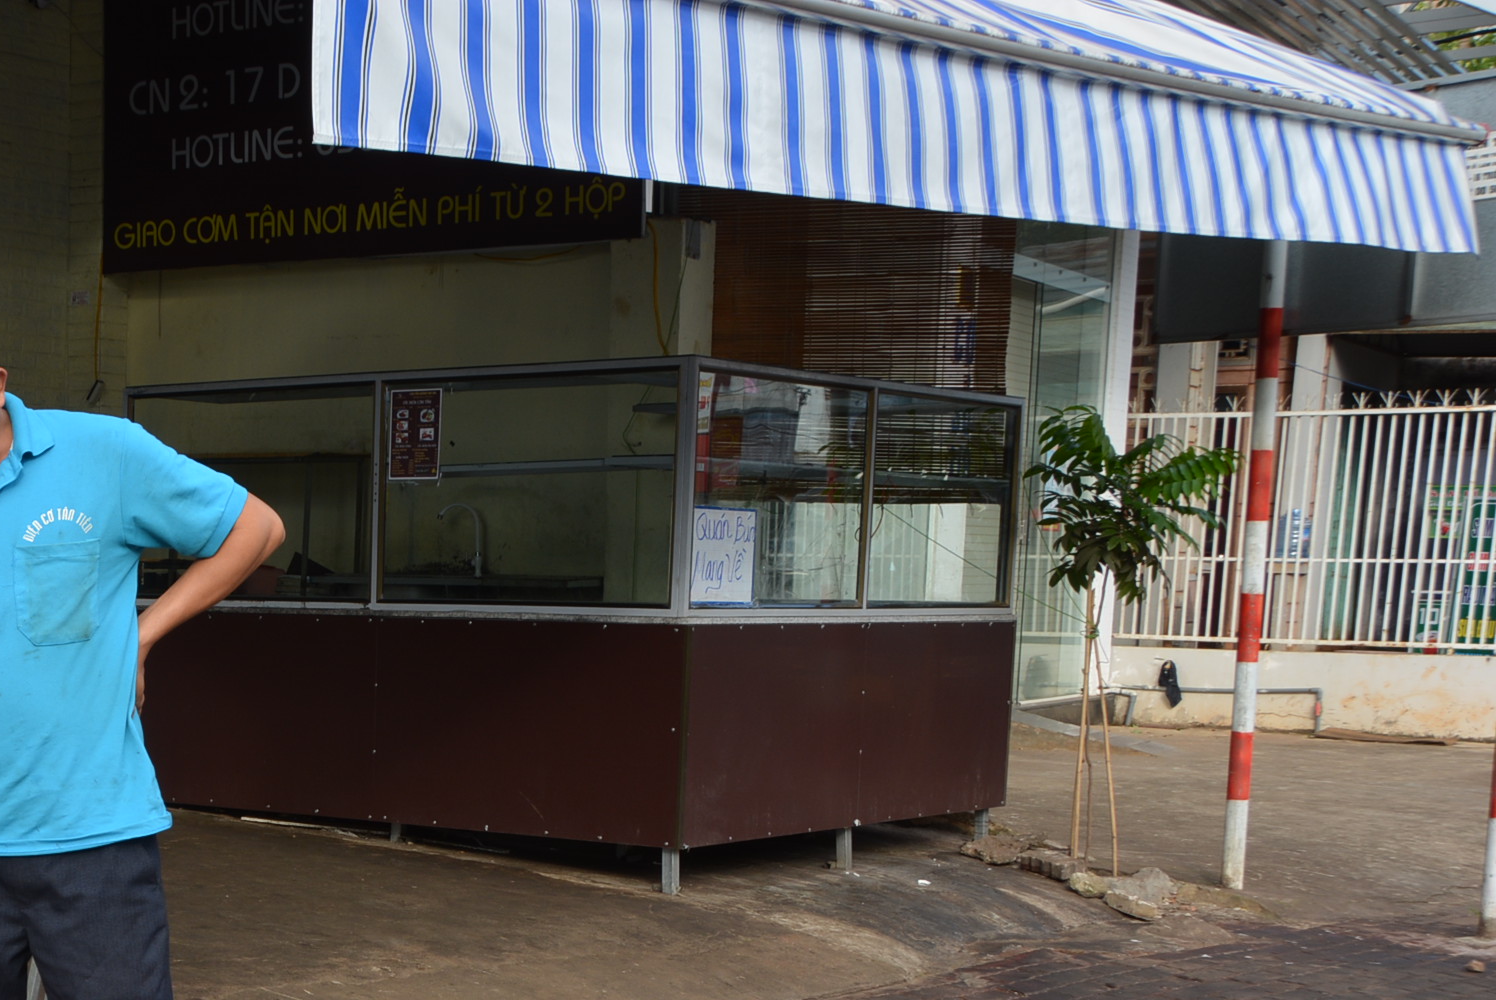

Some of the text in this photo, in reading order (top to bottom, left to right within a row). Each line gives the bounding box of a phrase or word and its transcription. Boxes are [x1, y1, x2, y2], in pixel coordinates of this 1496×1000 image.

[171, 0, 304, 40] HOTLINE:
[224, 65, 264, 105] 17
[171, 125, 304, 171] HOTLINE:
[113, 176, 627, 250] GIAO CƠM TẬN NƠI MIỄN PHÍ TỪ 2 HỘP
[695, 512, 733, 541] Quán
[725, 548, 747, 583] Về
